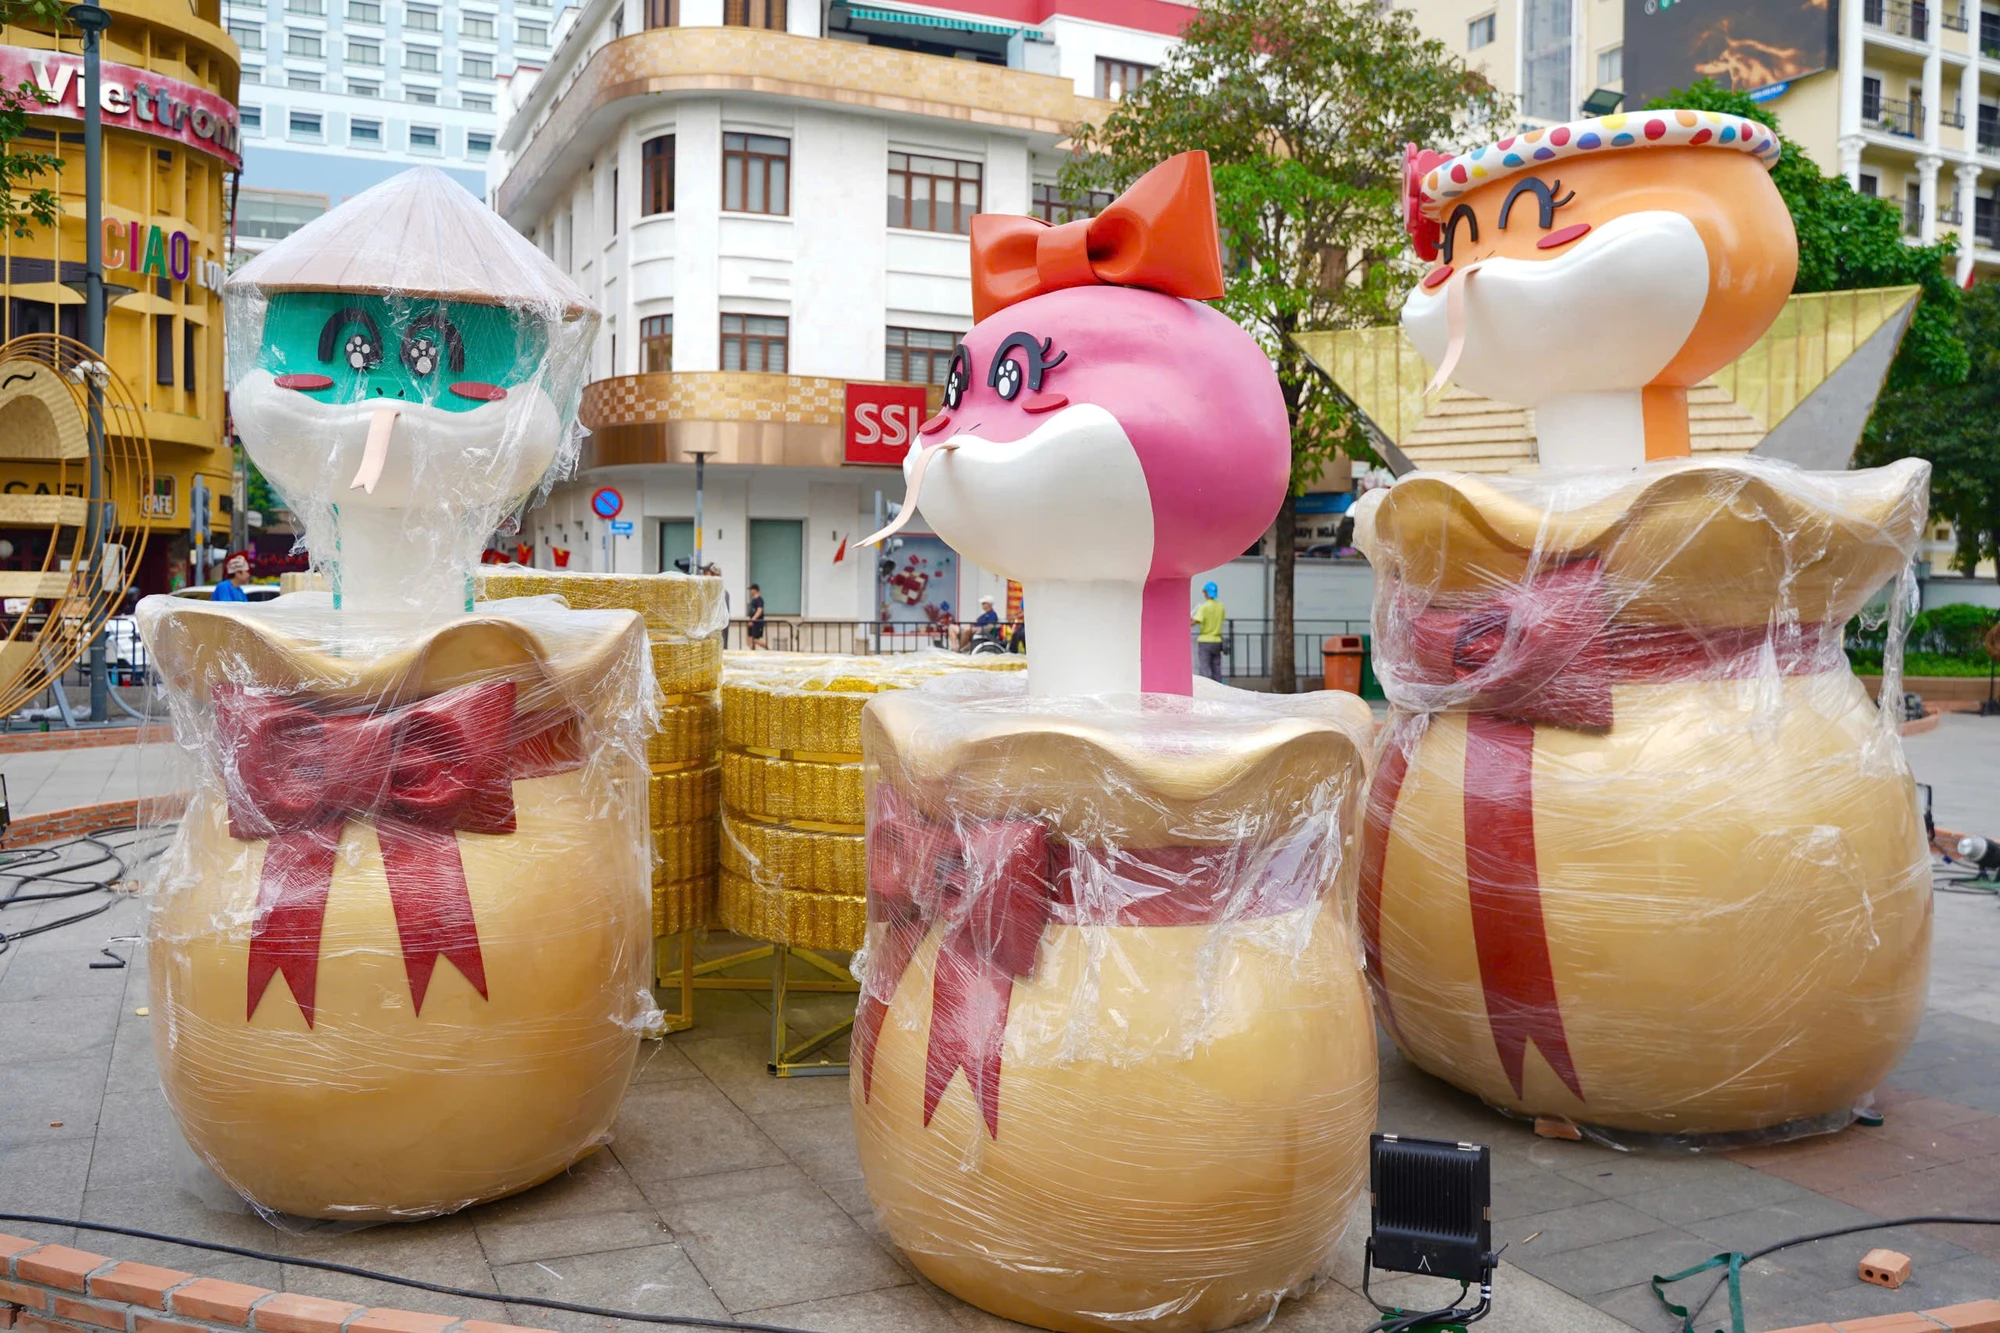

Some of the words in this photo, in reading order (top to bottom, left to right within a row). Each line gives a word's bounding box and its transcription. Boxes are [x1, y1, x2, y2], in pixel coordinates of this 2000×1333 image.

[101, 217, 190, 282] CIAO
[854, 402, 919, 446] SSI
[144, 494, 172, 514] CAFE
